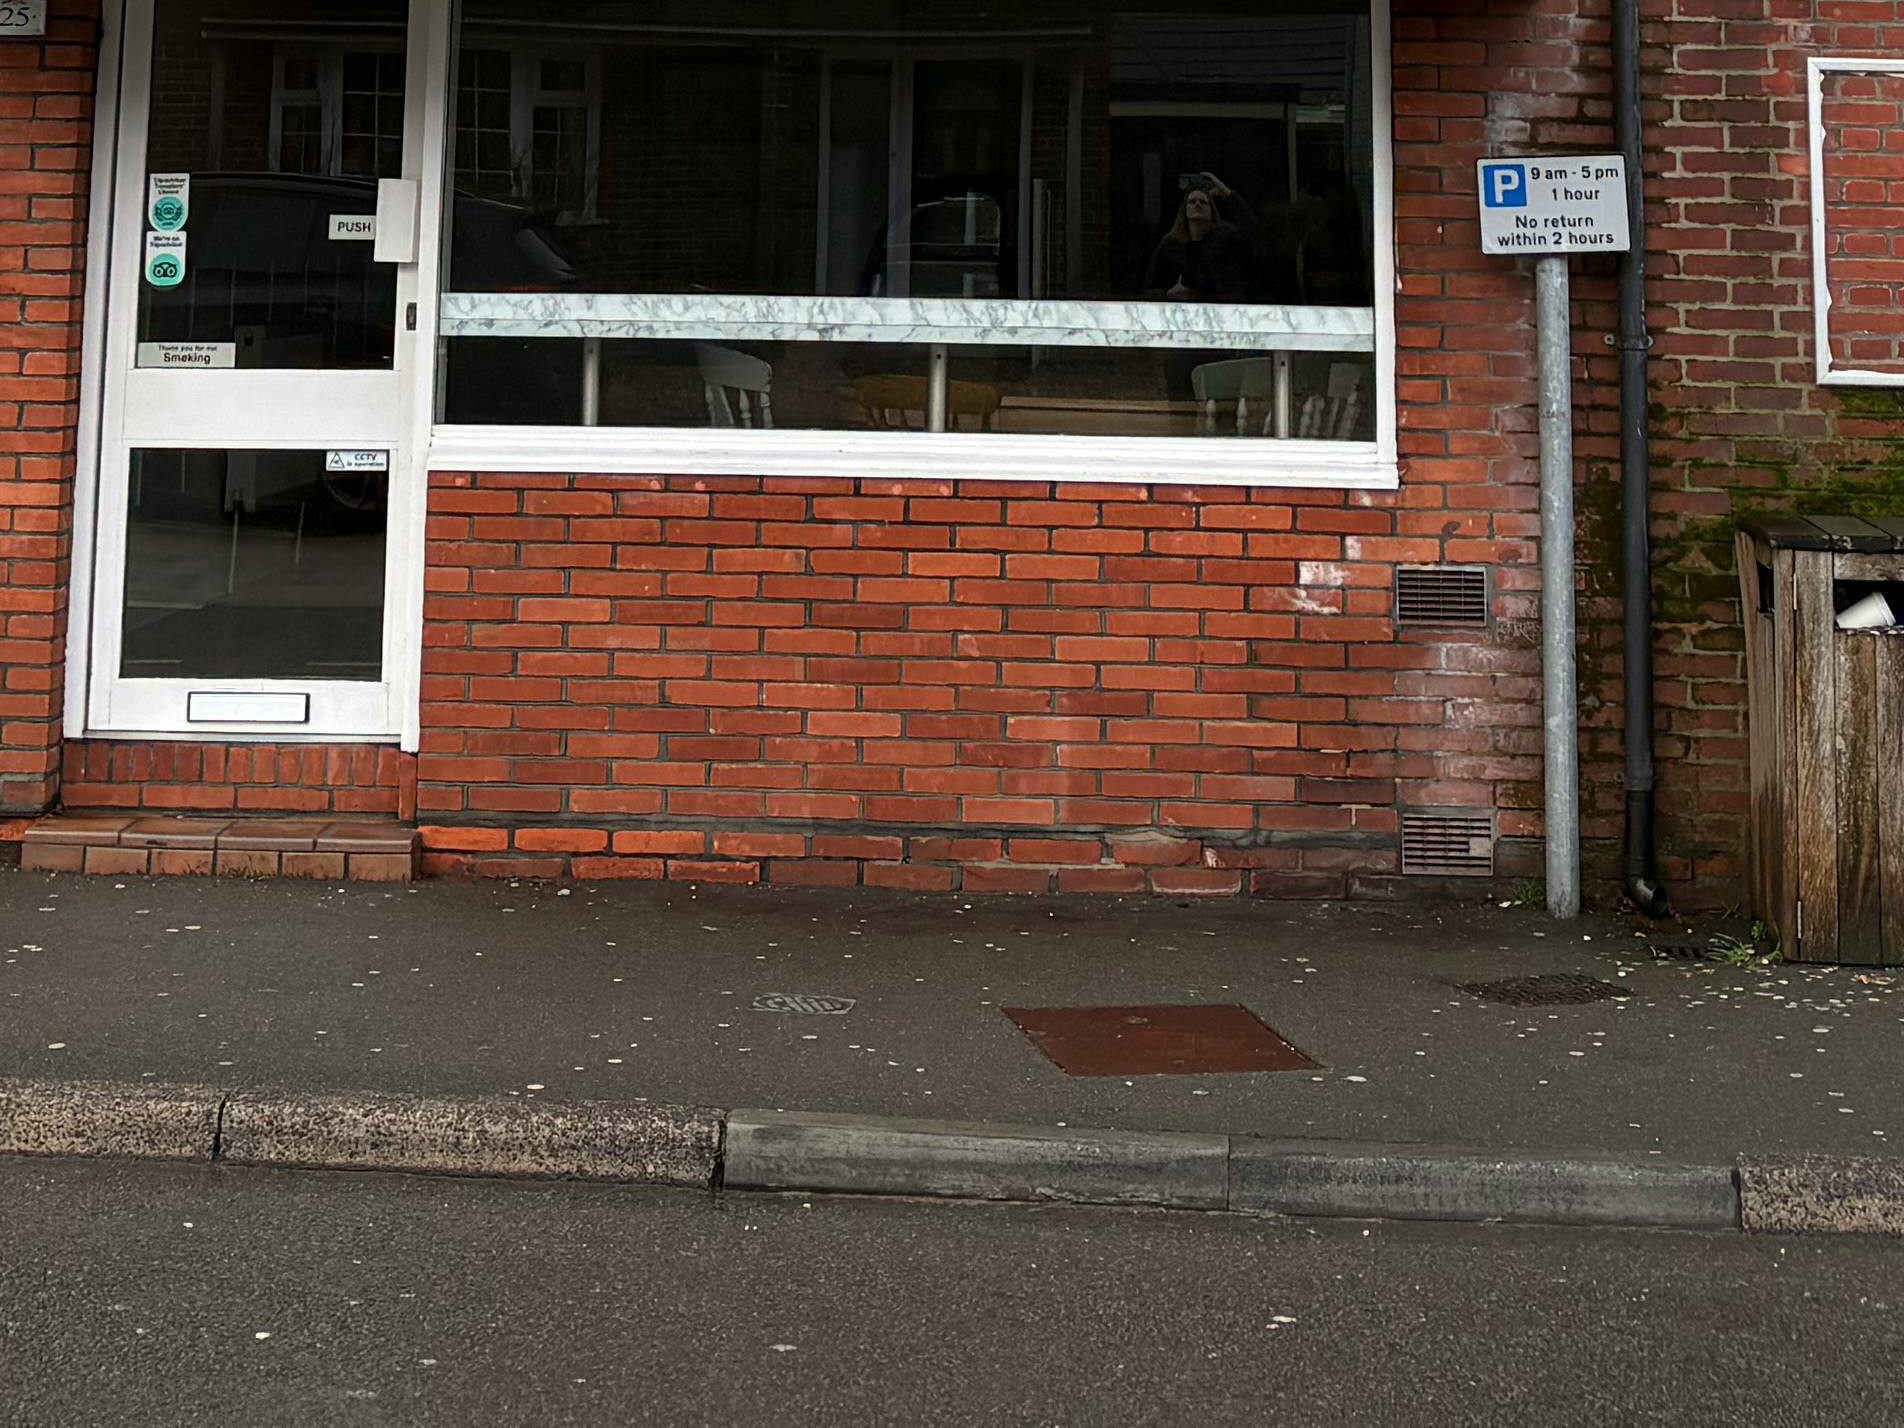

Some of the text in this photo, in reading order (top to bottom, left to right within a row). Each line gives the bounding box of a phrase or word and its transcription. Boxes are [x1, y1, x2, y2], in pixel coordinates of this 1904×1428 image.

[1493, 169, 1520, 204] P
[1530, 167, 1541, 180] 9
[1545, 168, 1567, 180] am
[1581, 165, 1591, 179] 5
[1595, 167, 1619, 181] pm
[1552, 187, 1600, 201] 1 hour
[337, 221, 371, 233] PUSH
[1515, 215, 1594, 229] No return
[1497, 231, 1615, 247] within 2 hours
[163, 352, 211, 366] Smoking
[354, 452, 377, 462] CCTV
